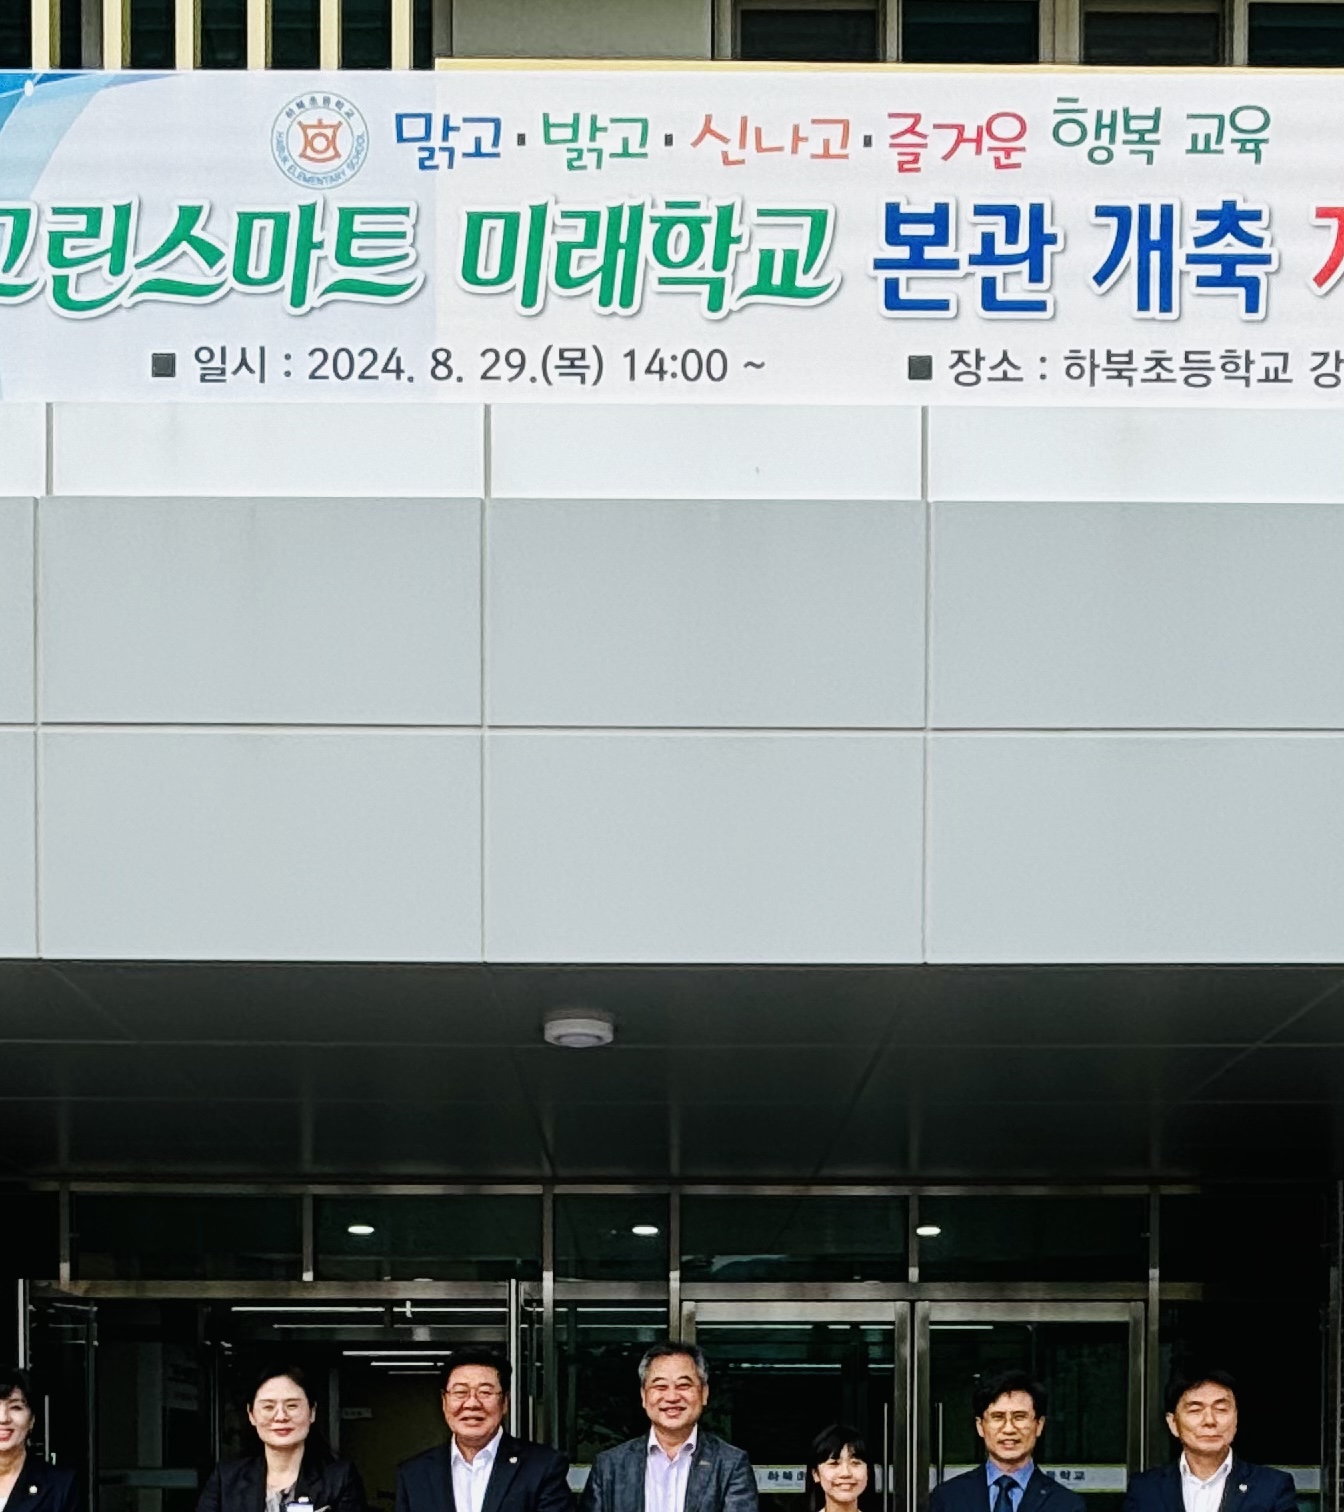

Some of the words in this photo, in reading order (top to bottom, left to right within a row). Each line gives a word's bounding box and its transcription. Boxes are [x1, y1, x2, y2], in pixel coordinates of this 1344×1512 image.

[887, 112, 1029, 175] 즐거운
[1053, 97, 1163, 167] 행복
[1186, 105, 1272, 166] 교육
[461, 200, 834, 315] 미래학교
[873, 202, 1060, 314] 본관
[1092, 202, 1274, 316] 개축
[193, 346, 267, 386] 일시
[308, 348, 416, 385] 2024.
[431, 348, 464, 385] 8.
[624, 349, 729, 384] 14:00
[949, 349, 1025, 388] 장소
[1064, 350, 1294, 389] 하북초등학교
